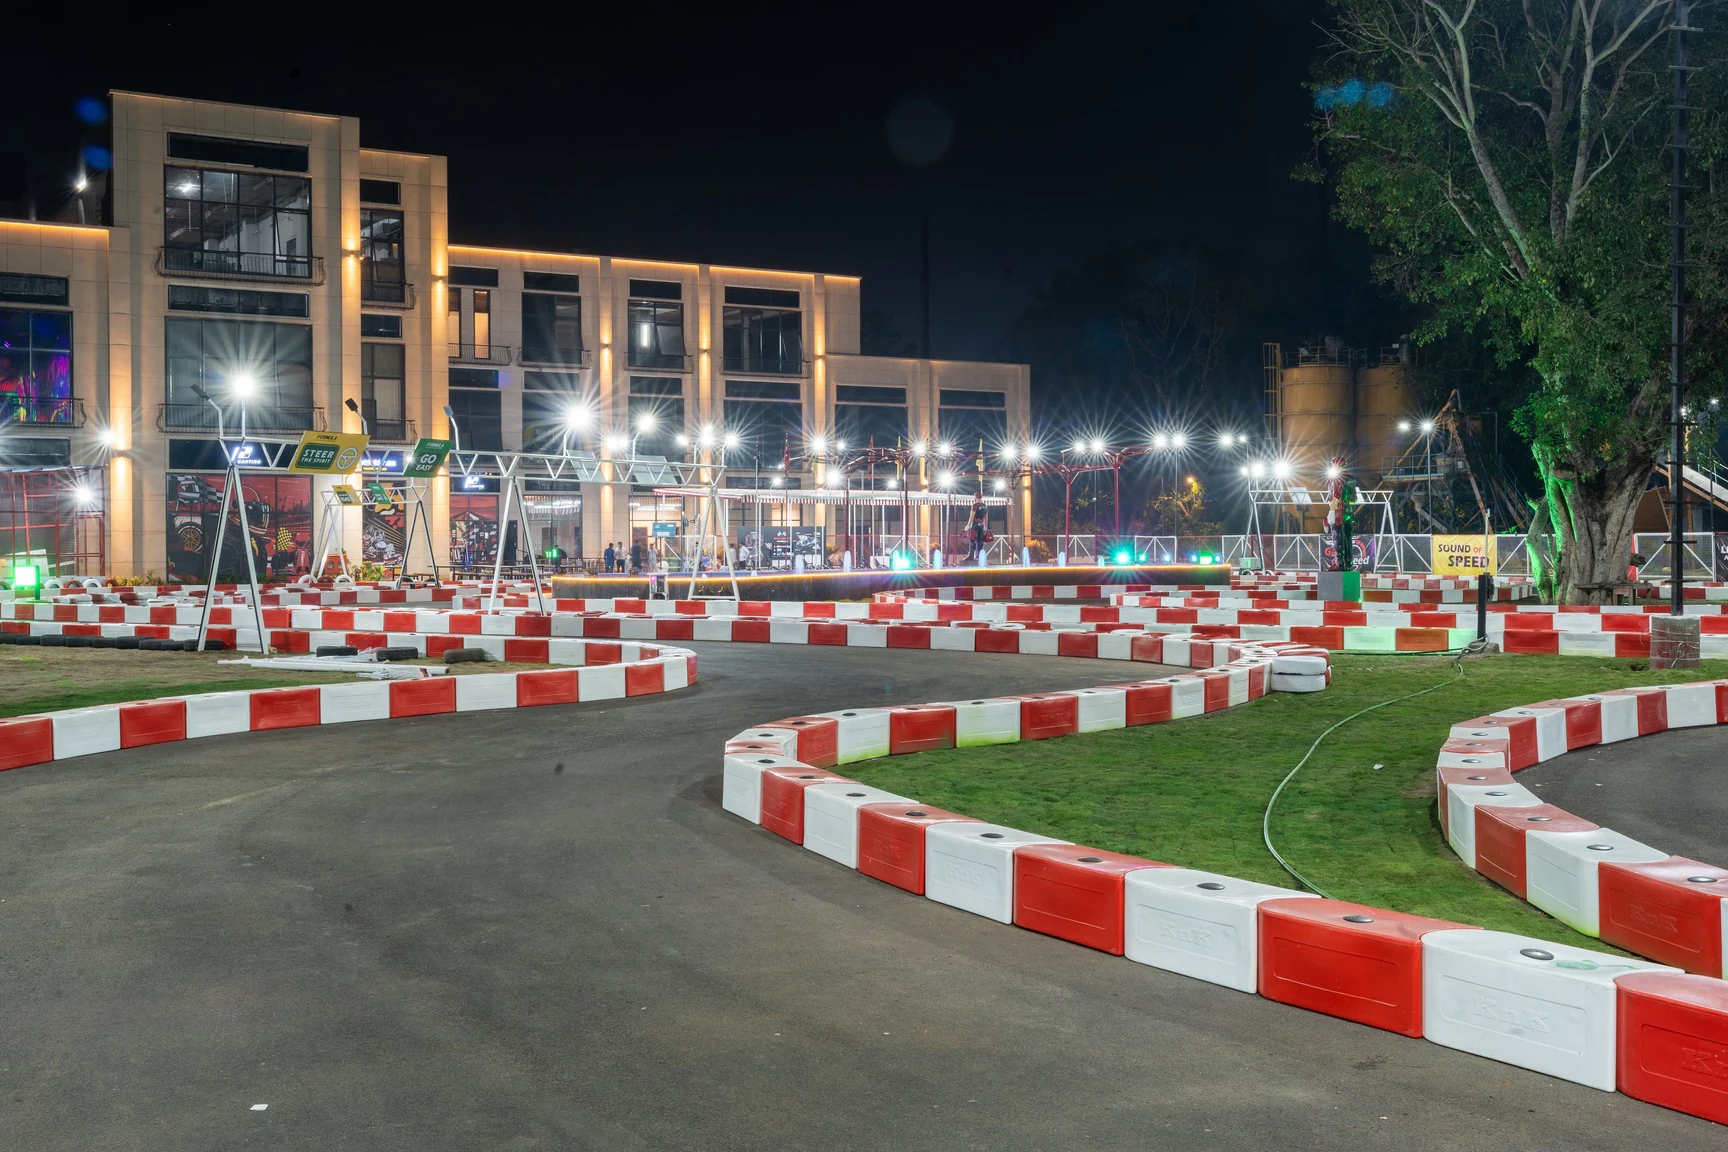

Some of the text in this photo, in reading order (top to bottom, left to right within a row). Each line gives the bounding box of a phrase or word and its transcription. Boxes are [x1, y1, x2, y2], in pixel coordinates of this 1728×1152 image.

[303, 449, 335, 459] STEER
[420, 454, 437, 464] GO
[1438, 544, 1471, 553] SOUND
[1448, 555, 1490, 568] SPEED
[1471, 994, 1551, 1034] KnK
